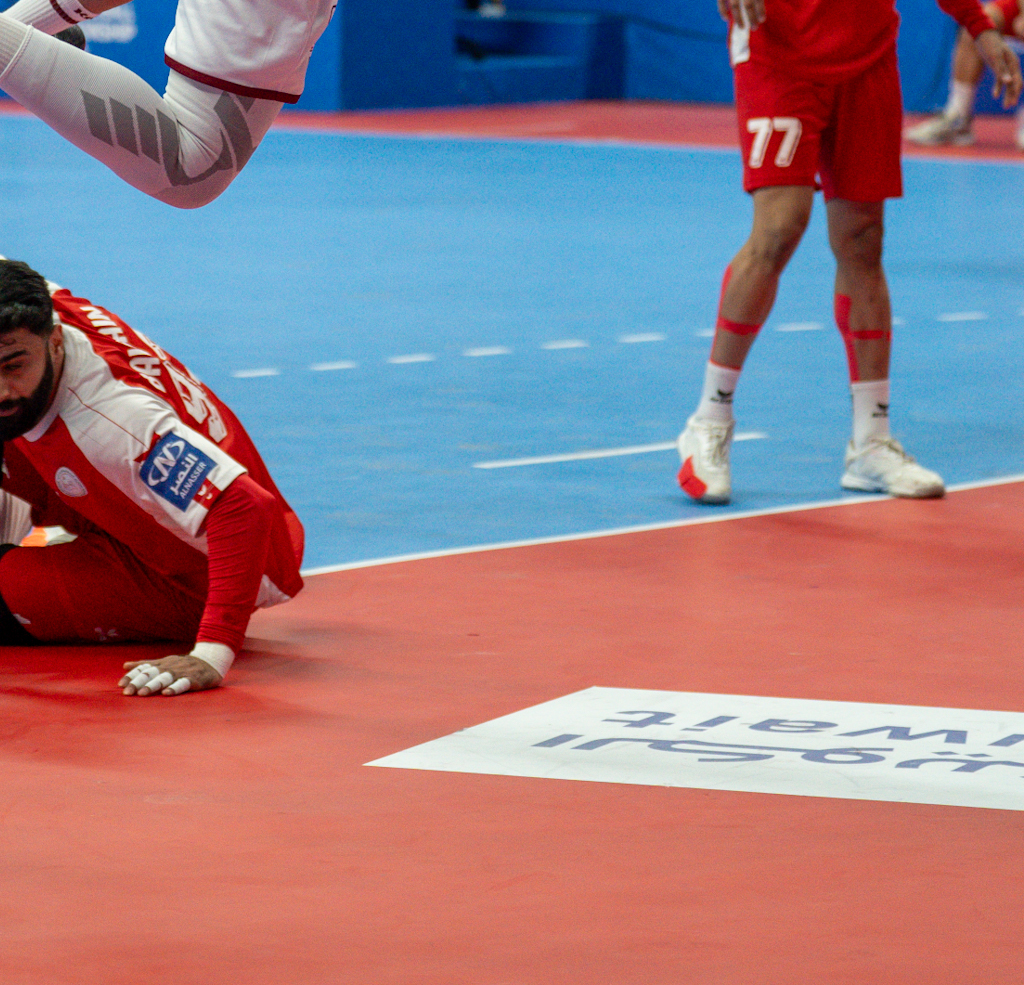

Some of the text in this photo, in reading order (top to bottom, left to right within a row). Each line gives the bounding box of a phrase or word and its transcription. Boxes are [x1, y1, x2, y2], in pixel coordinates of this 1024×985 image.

[747, 117, 802, 169] 77
[170, 453, 199, 496] النصر
[179, 461, 207, 500] ALNASSER
